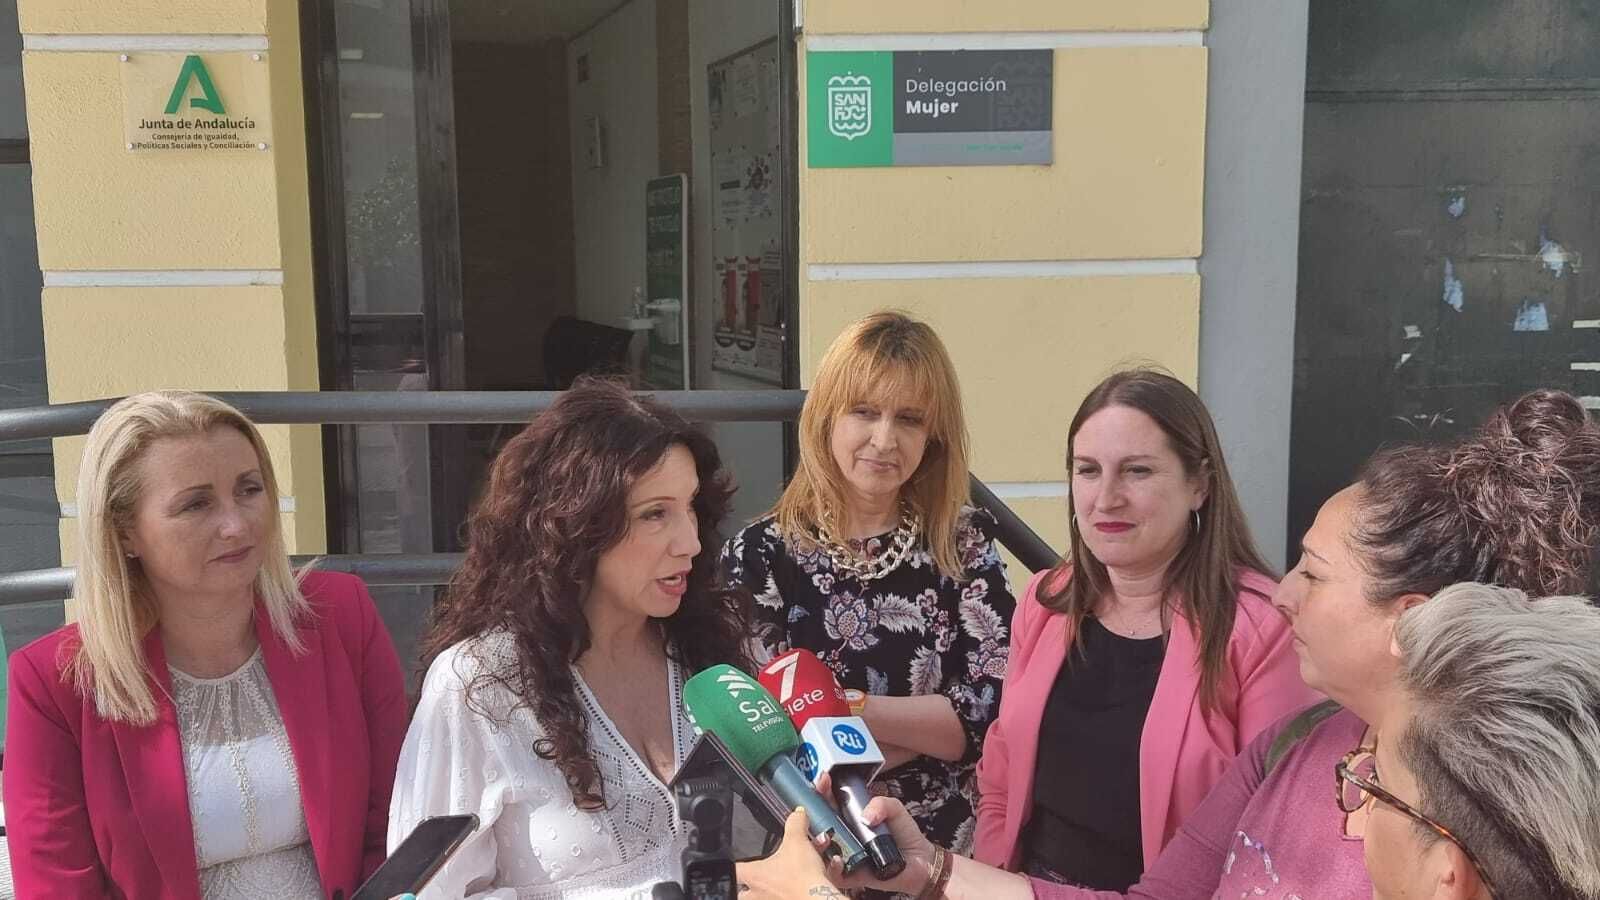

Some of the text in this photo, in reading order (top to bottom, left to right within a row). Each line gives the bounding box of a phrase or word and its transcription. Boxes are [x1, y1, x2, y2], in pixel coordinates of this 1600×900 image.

[905, 77, 1007, 97] Delegación
[905, 99, 959, 118] Mujer
[138, 117, 256, 130] Junta de Andalucía
[151, 132, 192, 142] Consejería
[193, 132, 203, 141] de
[137, 141, 170, 150] Políticas
[170, 141, 202, 150] Sociales
[209, 141, 256, 150] Conciliación
[765, 651, 801, 704] 7
